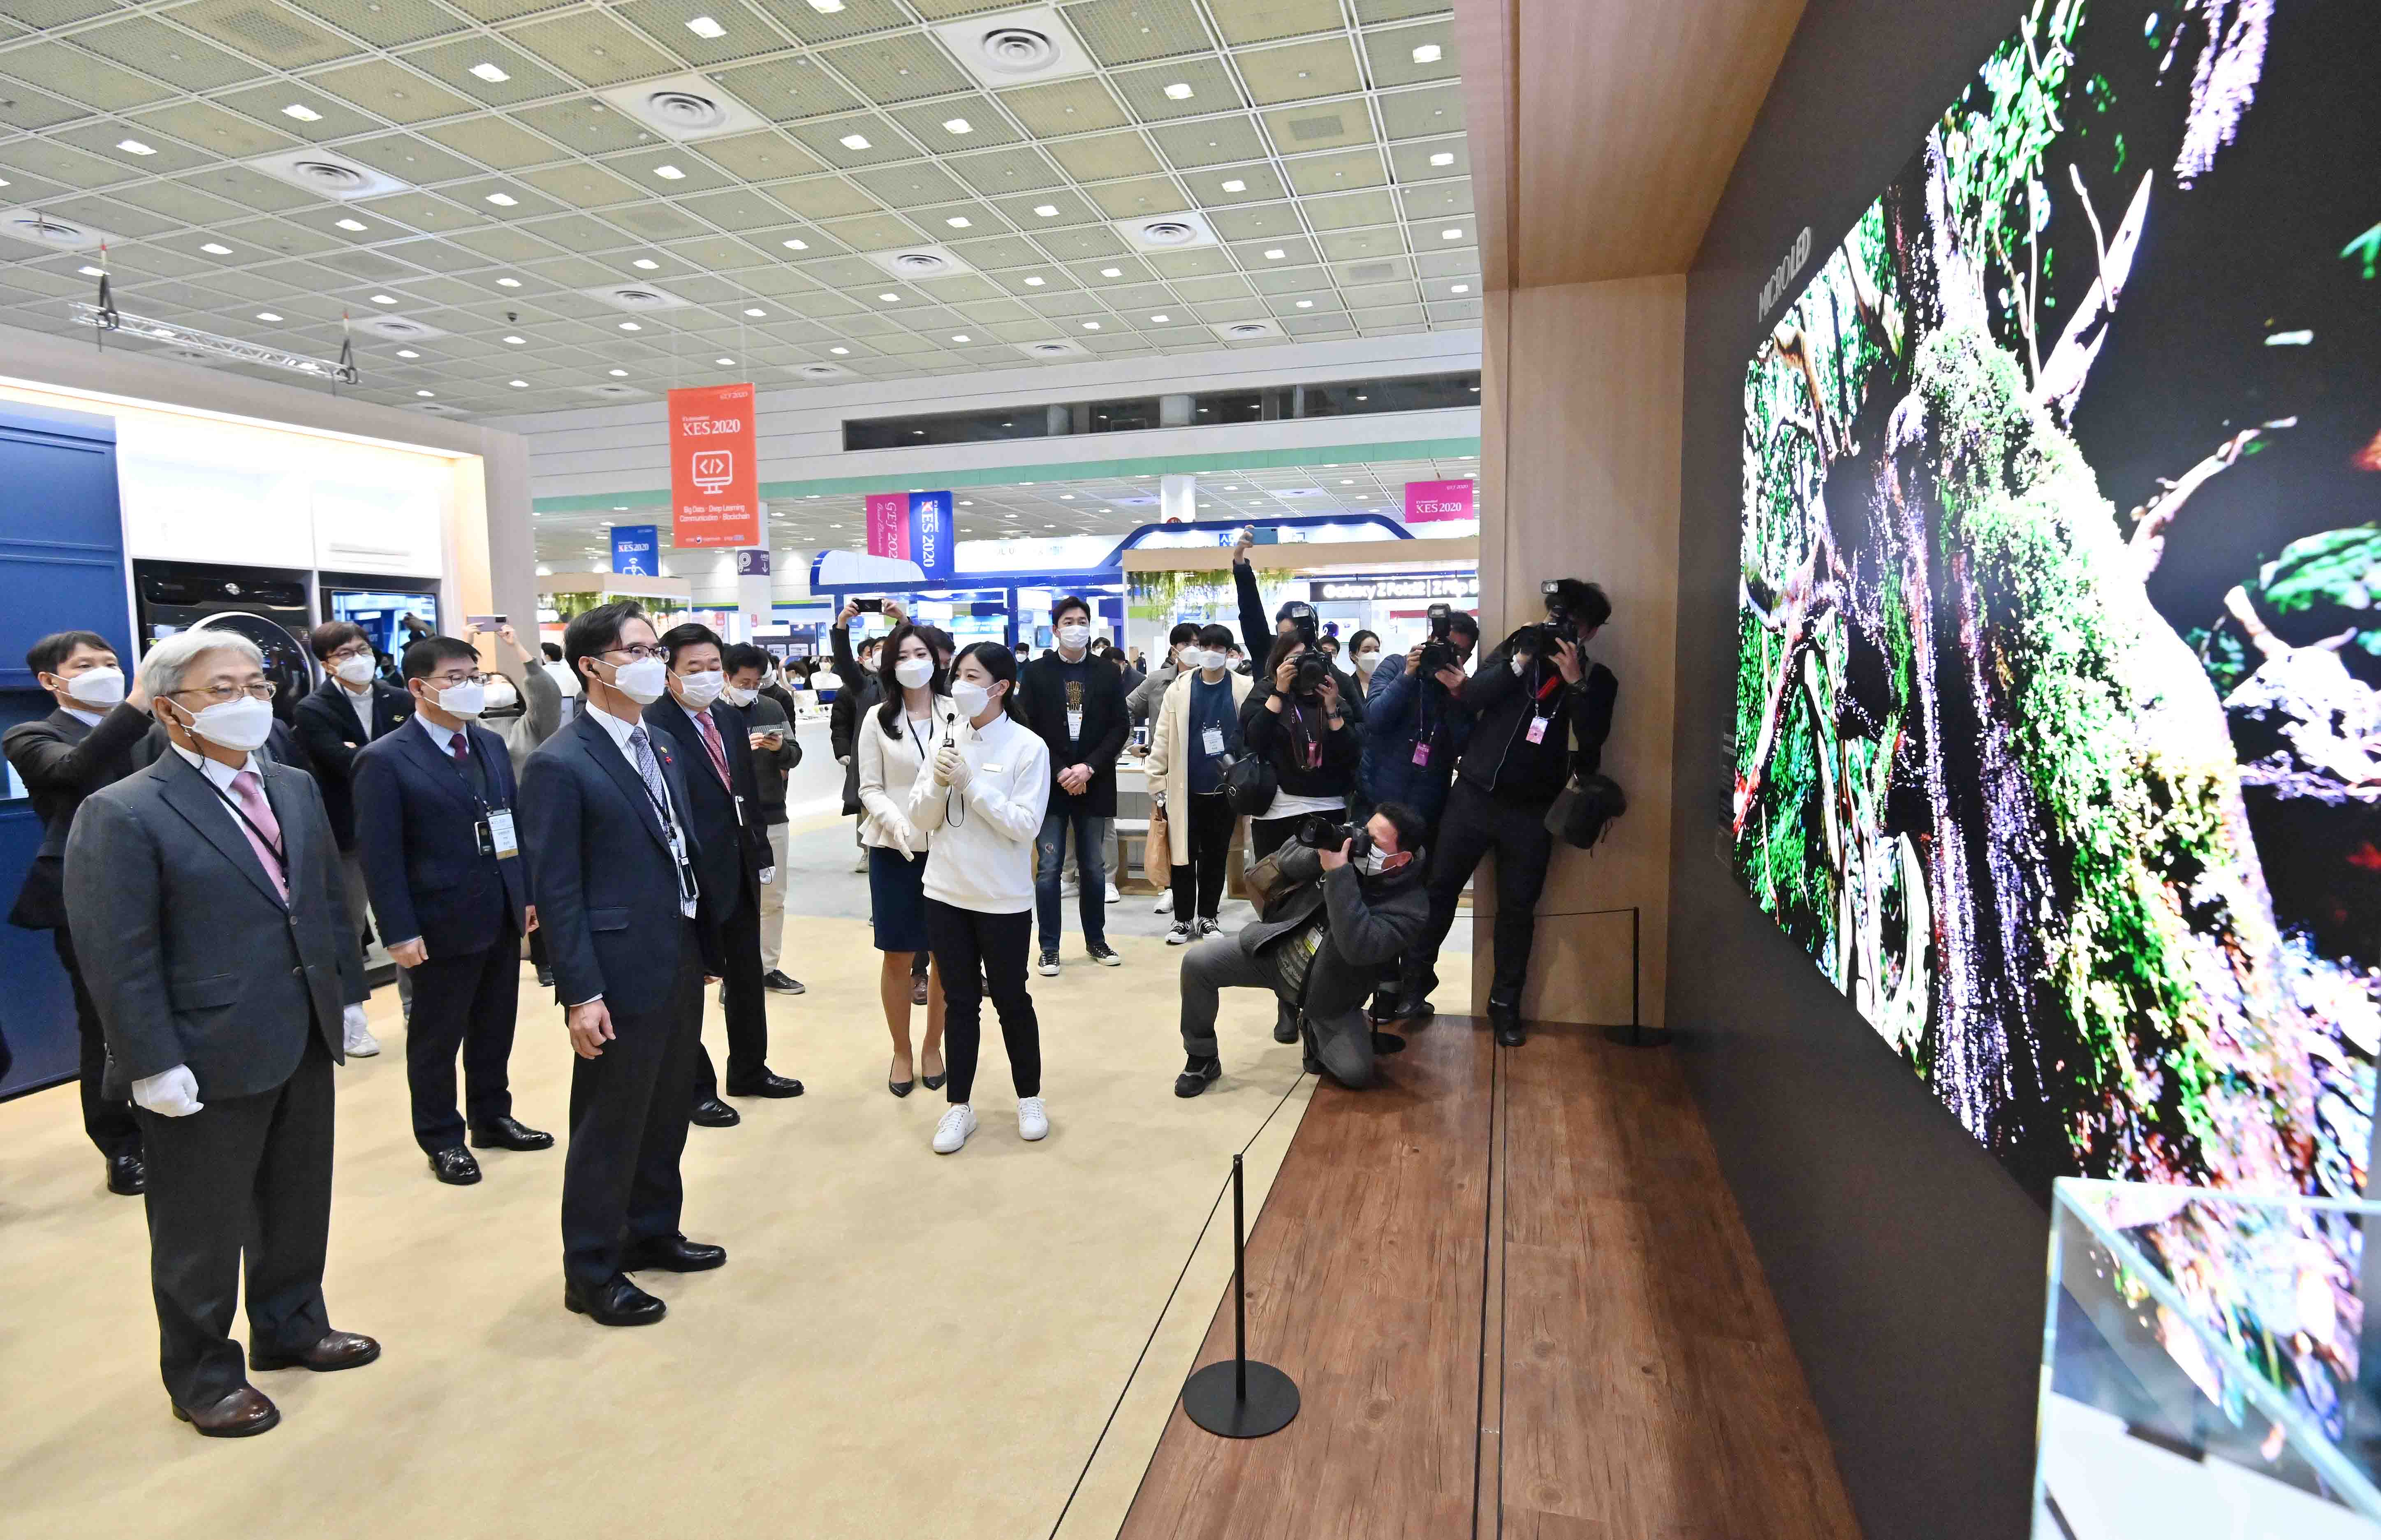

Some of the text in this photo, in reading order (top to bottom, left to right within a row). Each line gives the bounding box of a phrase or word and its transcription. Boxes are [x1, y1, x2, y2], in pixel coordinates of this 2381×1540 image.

[1790, 227, 1811, 281] LED
[683, 419, 740, 436] KES 2020
[1416, 502, 1462, 513] KES 2020
[921, 500, 935, 567] KES 2020
[618, 543, 649, 553] KES 2020
[888, 532, 899, 559] 202
[1323, 584, 1377, 600] Galaxy
[1377, 583, 1387, 597] Z
[1387, 582, 1426, 596] Fold2
[1432, 580, 1443, 595] Z
[1443, 579, 1468, 598] Flip
